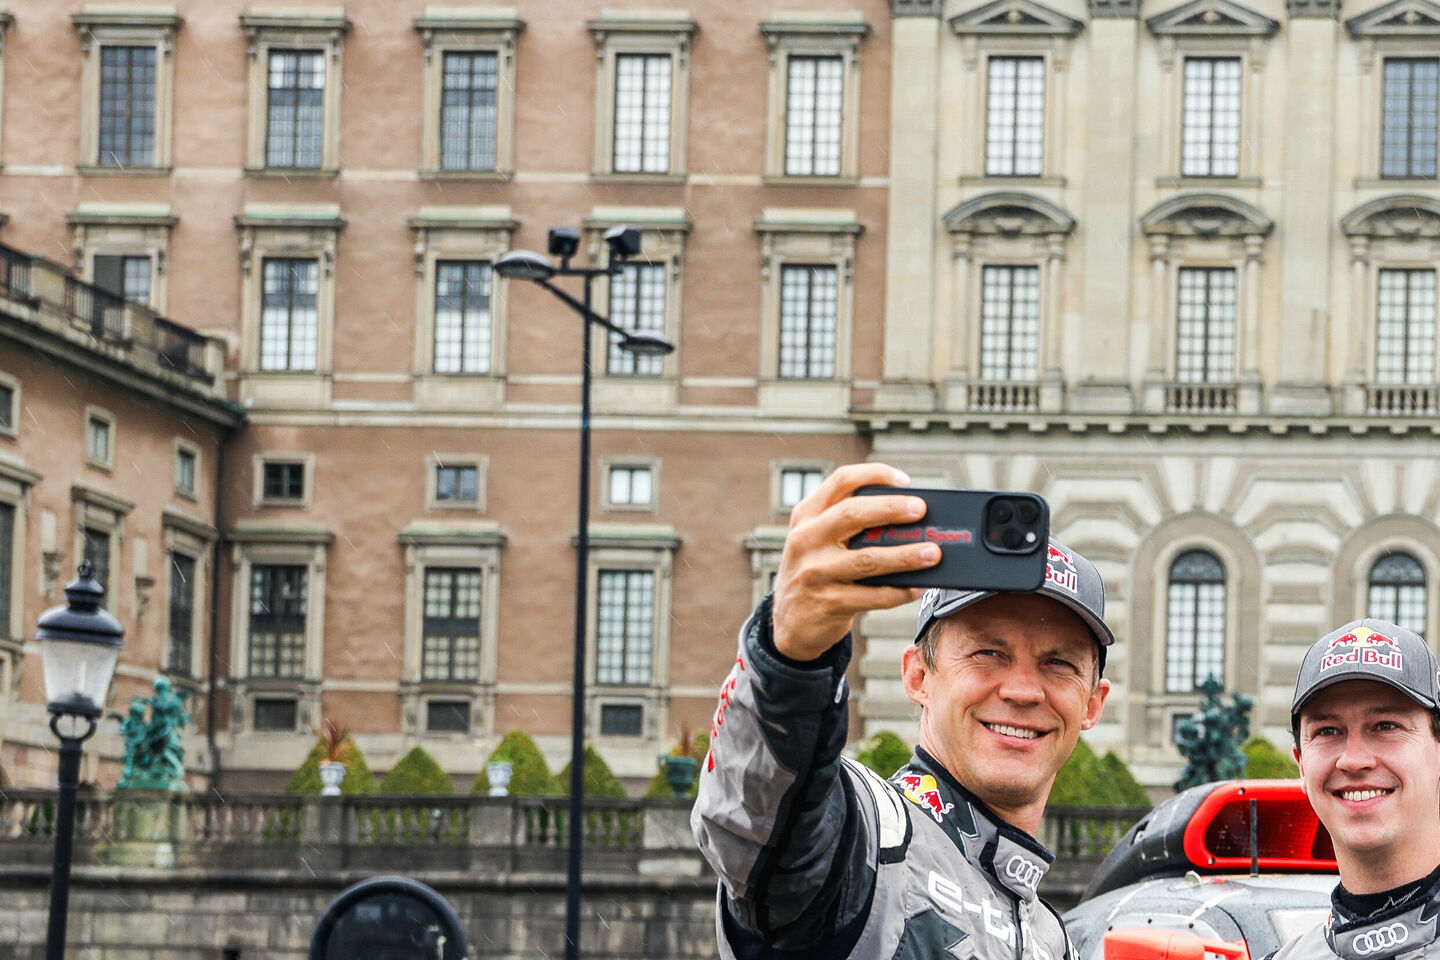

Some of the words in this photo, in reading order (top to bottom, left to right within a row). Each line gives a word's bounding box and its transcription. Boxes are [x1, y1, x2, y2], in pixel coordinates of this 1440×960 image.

[885, 527, 922, 540] Audi
[925, 528, 971, 543] Sport
[1321, 649, 1360, 671] Red
[1363, 649, 1401, 670] Bull
